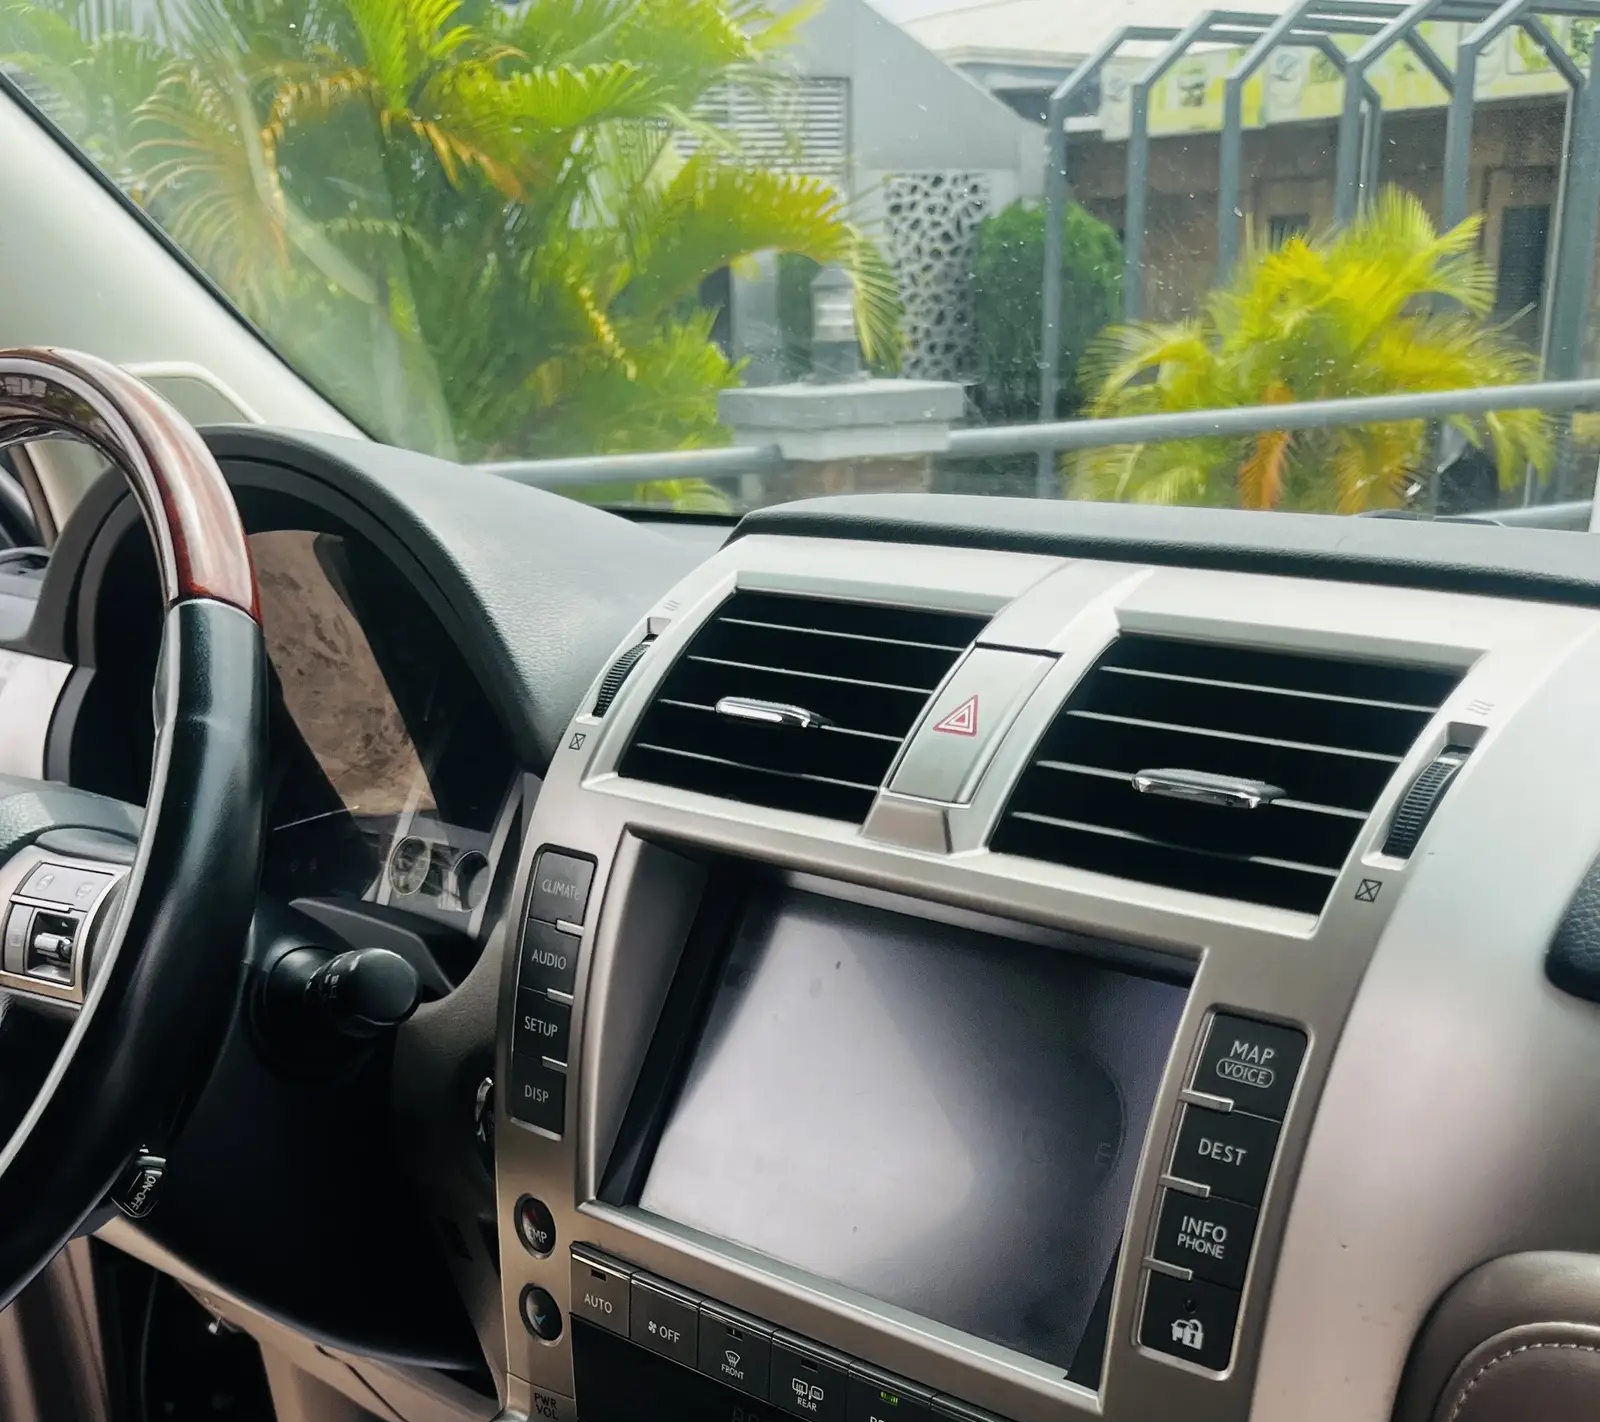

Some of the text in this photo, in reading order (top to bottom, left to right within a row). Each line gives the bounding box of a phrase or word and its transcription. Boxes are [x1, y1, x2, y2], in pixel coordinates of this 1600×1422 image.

[531, 948, 567, 971] AUDIO
[524, 1015, 558, 1038] SETUP
[1229, 1040, 1274, 1065] MAP
[1220, 1060, 1267, 1085] VOICE
[524, 1085, 549, 1104] DISP
[1198, 1138, 1247, 1166] DEST
[526, 1226, 548, 1244] EMP
[1181, 1215, 1227, 1243] INFO
[1177, 1233, 1225, 1259] PHONE
[584, 1293, 613, 1314] AUTO
[659, 1325, 681, 1344] OFF
[721, 1363, 745, 1380] FRONT
[534, 1392, 558, 1409] PWR
[797, 1396, 818, 1412] REAR
[535, 1404, 559, 1420] VOL
